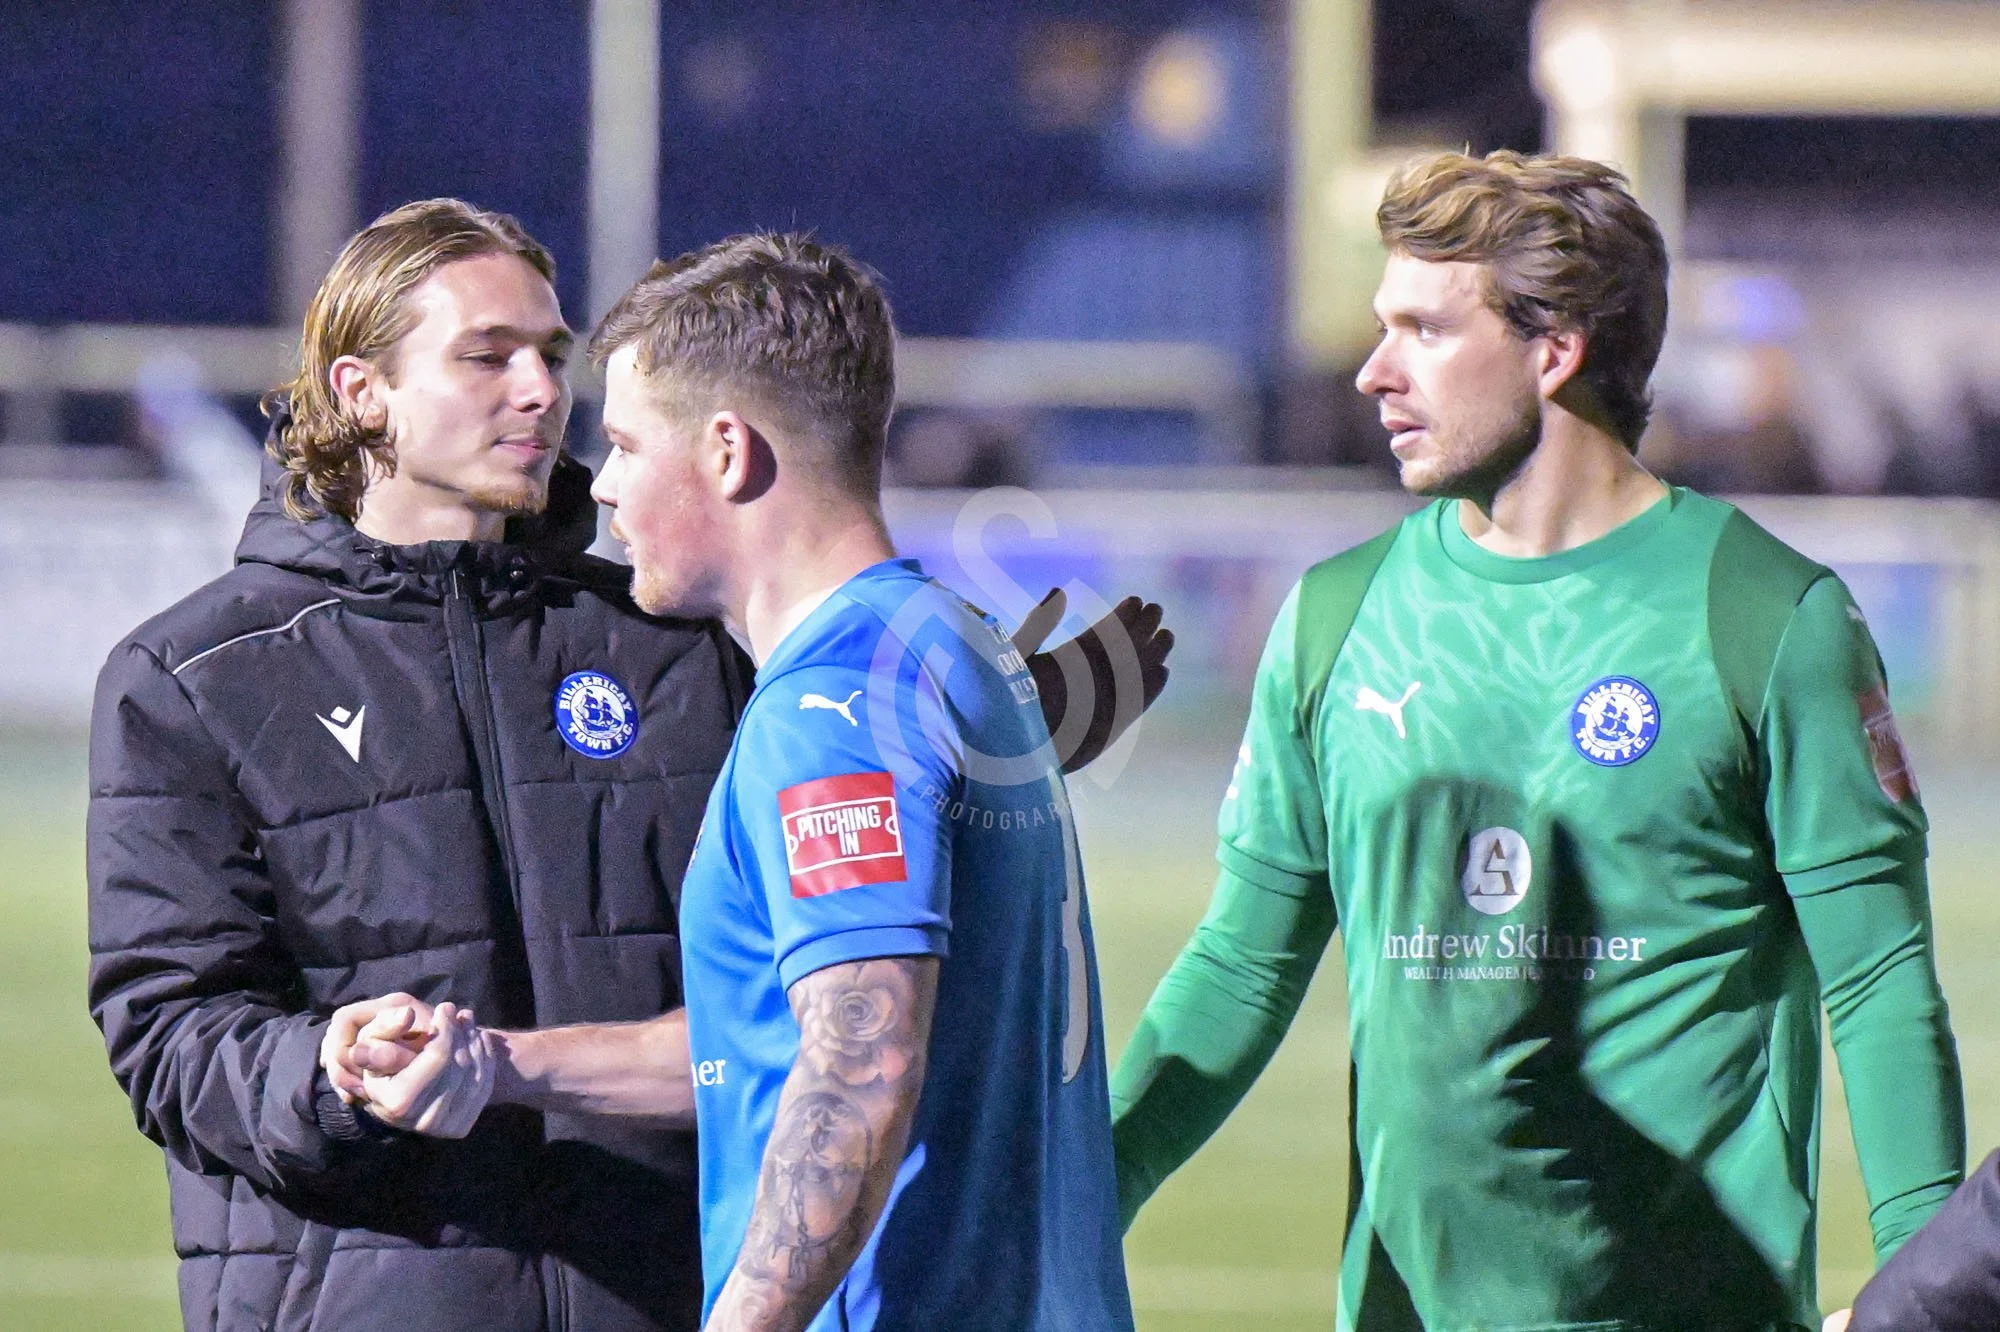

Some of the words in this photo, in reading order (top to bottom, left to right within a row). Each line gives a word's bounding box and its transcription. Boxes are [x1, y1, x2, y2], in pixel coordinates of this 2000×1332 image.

[559, 676, 633, 711] BILLERICAY
[1577, 682, 1655, 725] BILLERICAY
[568, 722, 612, 751] TOWN
[1576, 727, 1616, 761] TOWN
[796, 804, 881, 842] PITCHING
[839, 831, 860, 856] IN
[1497, 923, 1648, 962] Skinner
[1404, 966, 1454, 981] WEALTH
